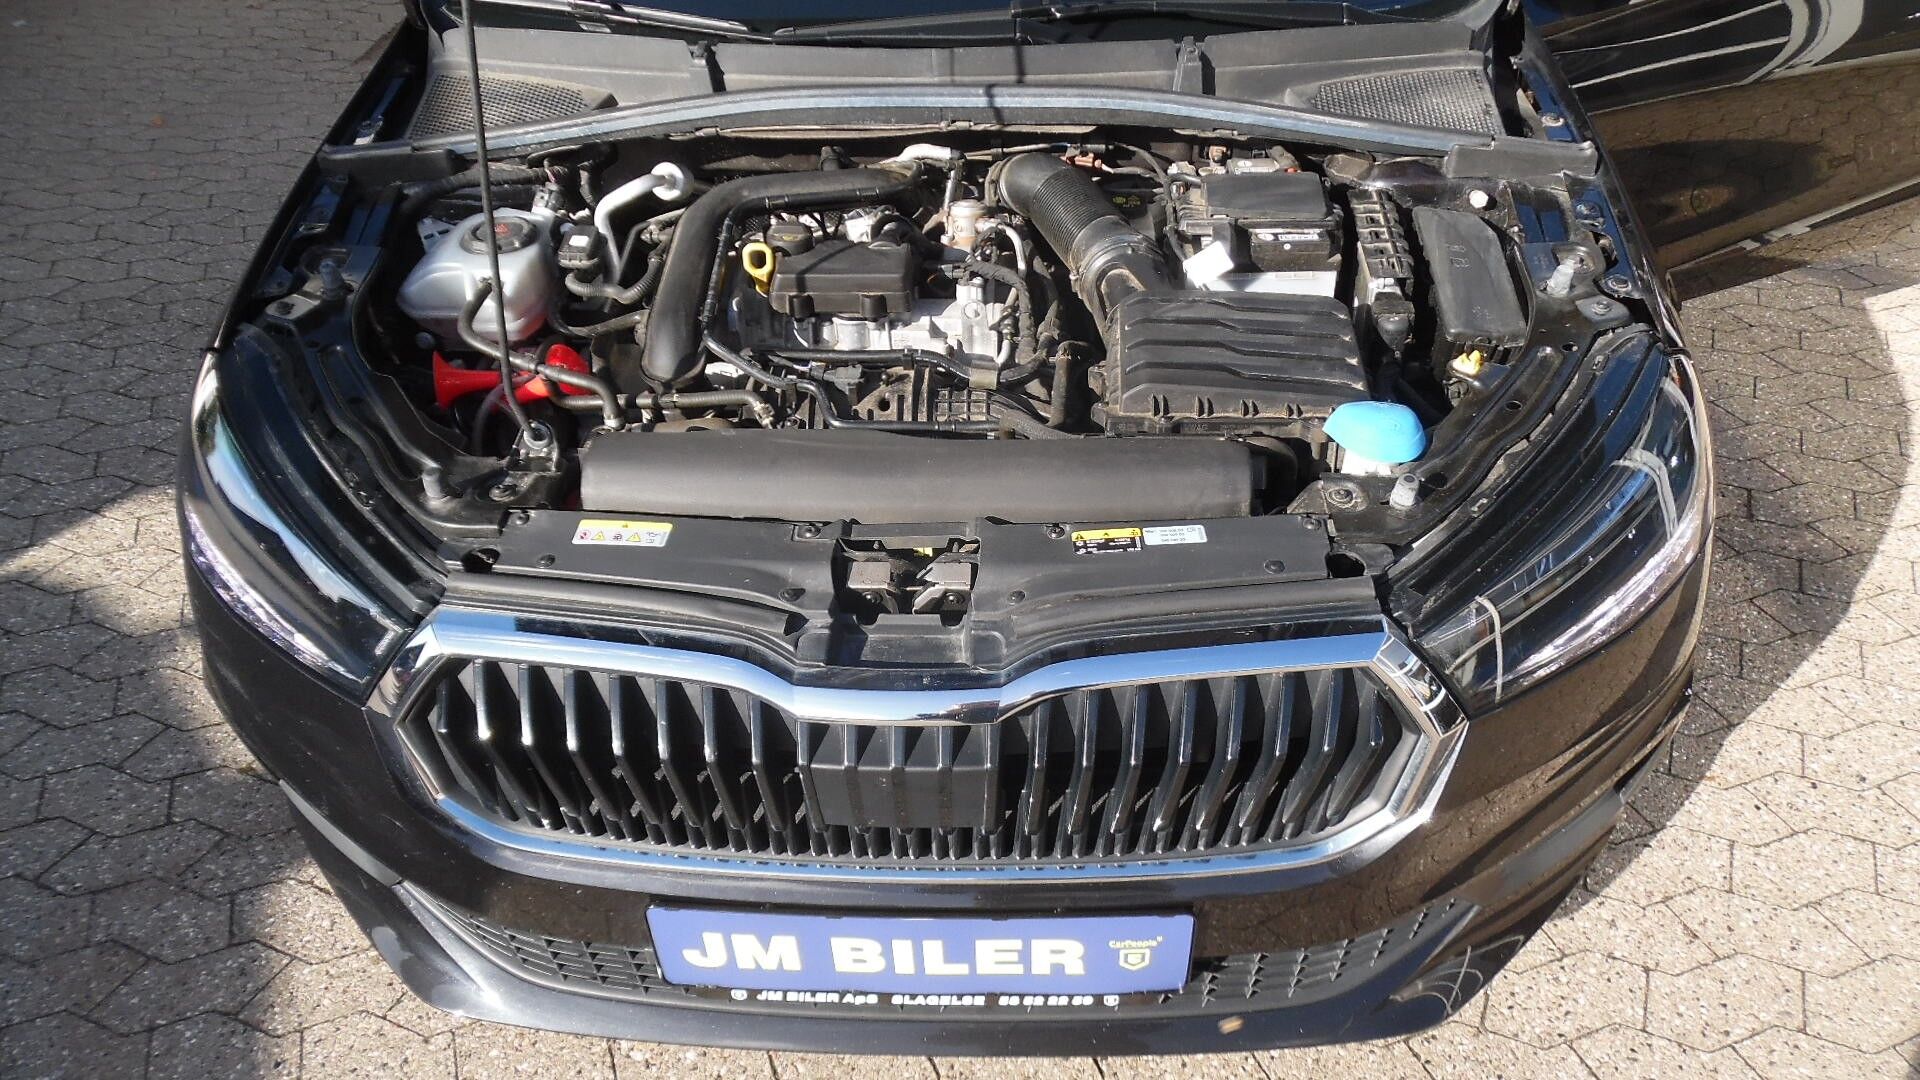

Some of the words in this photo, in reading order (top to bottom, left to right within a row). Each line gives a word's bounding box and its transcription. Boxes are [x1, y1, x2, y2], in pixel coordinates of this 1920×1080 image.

[682, 931, 803, 972] JM
[830, 936, 1086, 976] BILER
[756, 990, 784, 1001] JM
